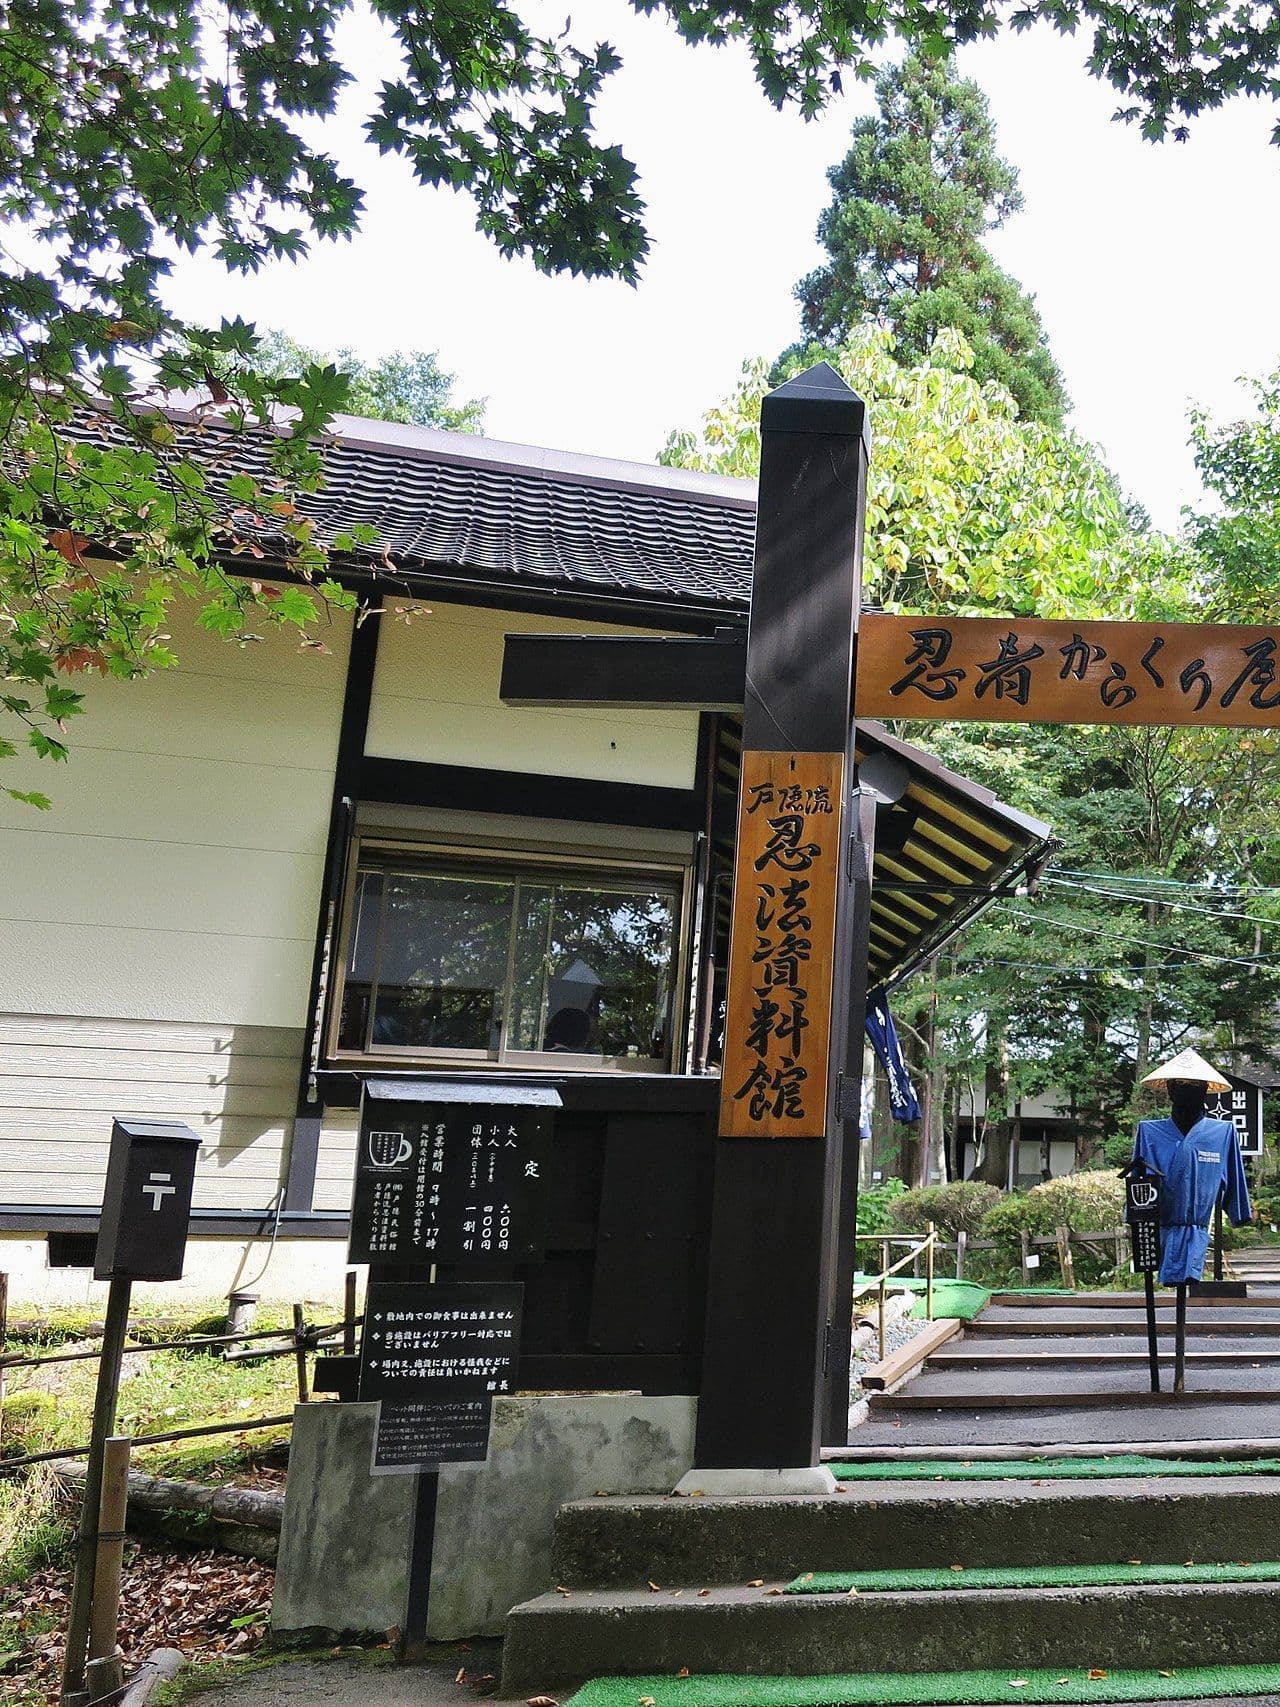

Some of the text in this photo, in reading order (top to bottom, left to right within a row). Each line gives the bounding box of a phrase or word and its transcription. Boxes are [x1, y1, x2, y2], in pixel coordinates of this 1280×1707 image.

[745, 782, 833, 814] 戸隠流
[733, 815, 822, 1121] 忍法資料館
[432, 1123, 446, 1173] 営業時間
[470, 1125, 482, 1149] 団体
[487, 1125, 500, 1148] 小人
[504, 1125, 518, 1148] 大人
[524, 1159, 540, 1178] 定
[462, 1206, 477, 1250] 一割引
[386, 1311, 514, 1322] 敷地内での御食事は出来ません
[384, 1340, 440, 1349] ございません
[385, 1329, 512, 1341] 当施設はバリアフリー対応では
[486, 1380, 509, 1391] 館長
